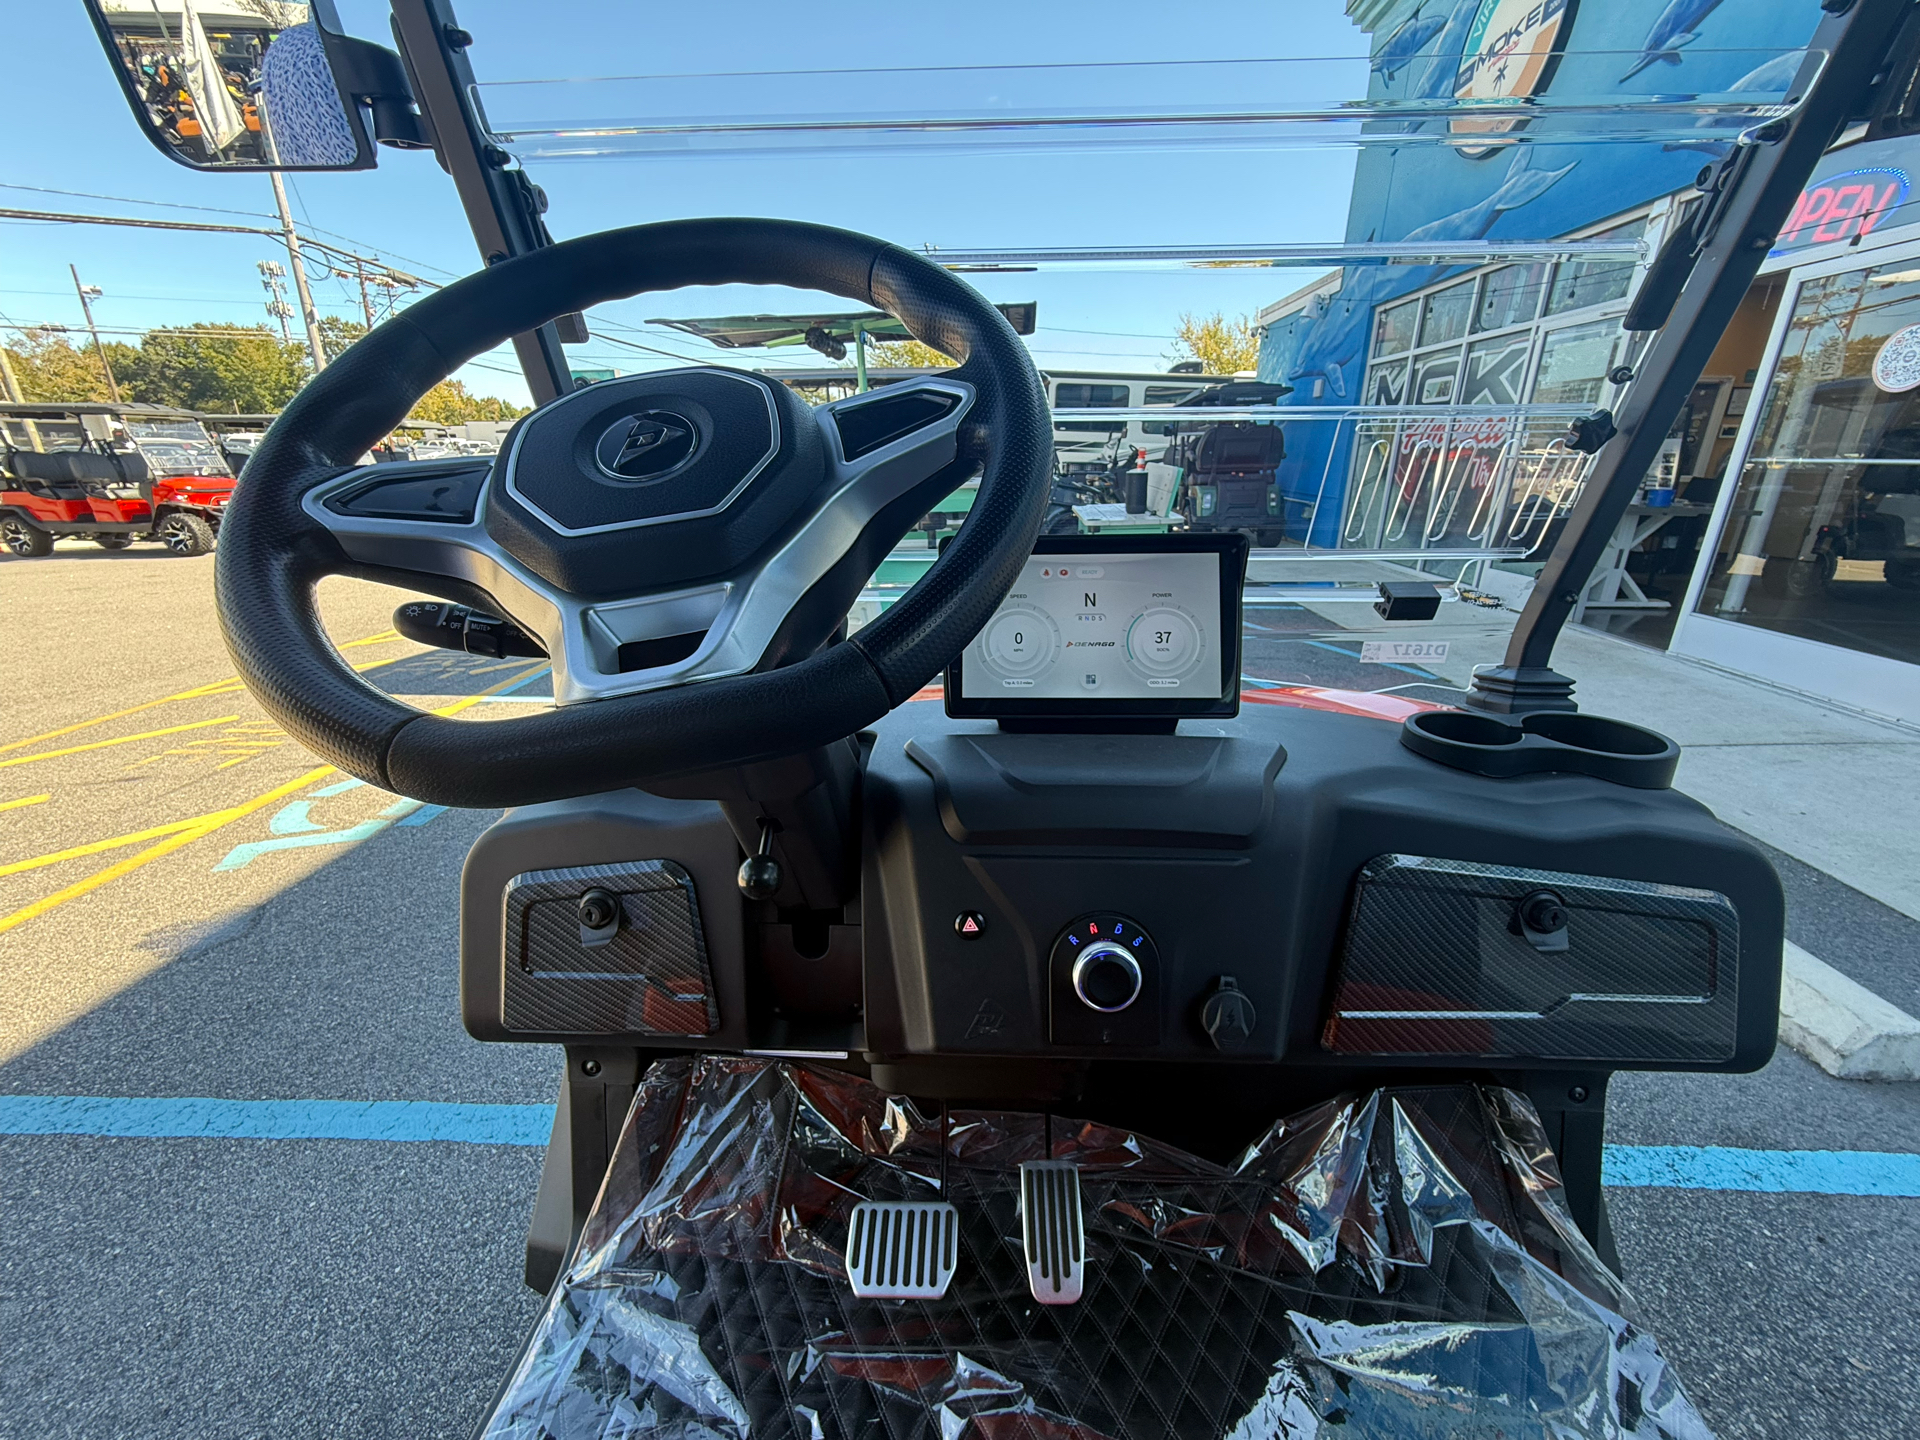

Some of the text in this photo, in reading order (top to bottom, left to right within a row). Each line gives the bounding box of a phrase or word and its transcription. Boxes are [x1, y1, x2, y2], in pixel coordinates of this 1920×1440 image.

[1475, 3, 1542, 72] MOKE
[1084, 592, 1097, 608] N
[450, 621, 462, 630] OFF
[471, 623, 487, 631] MUTE
[1014, 631, 1024, 645] 0
[1154, 631, 1172, 644] 37
